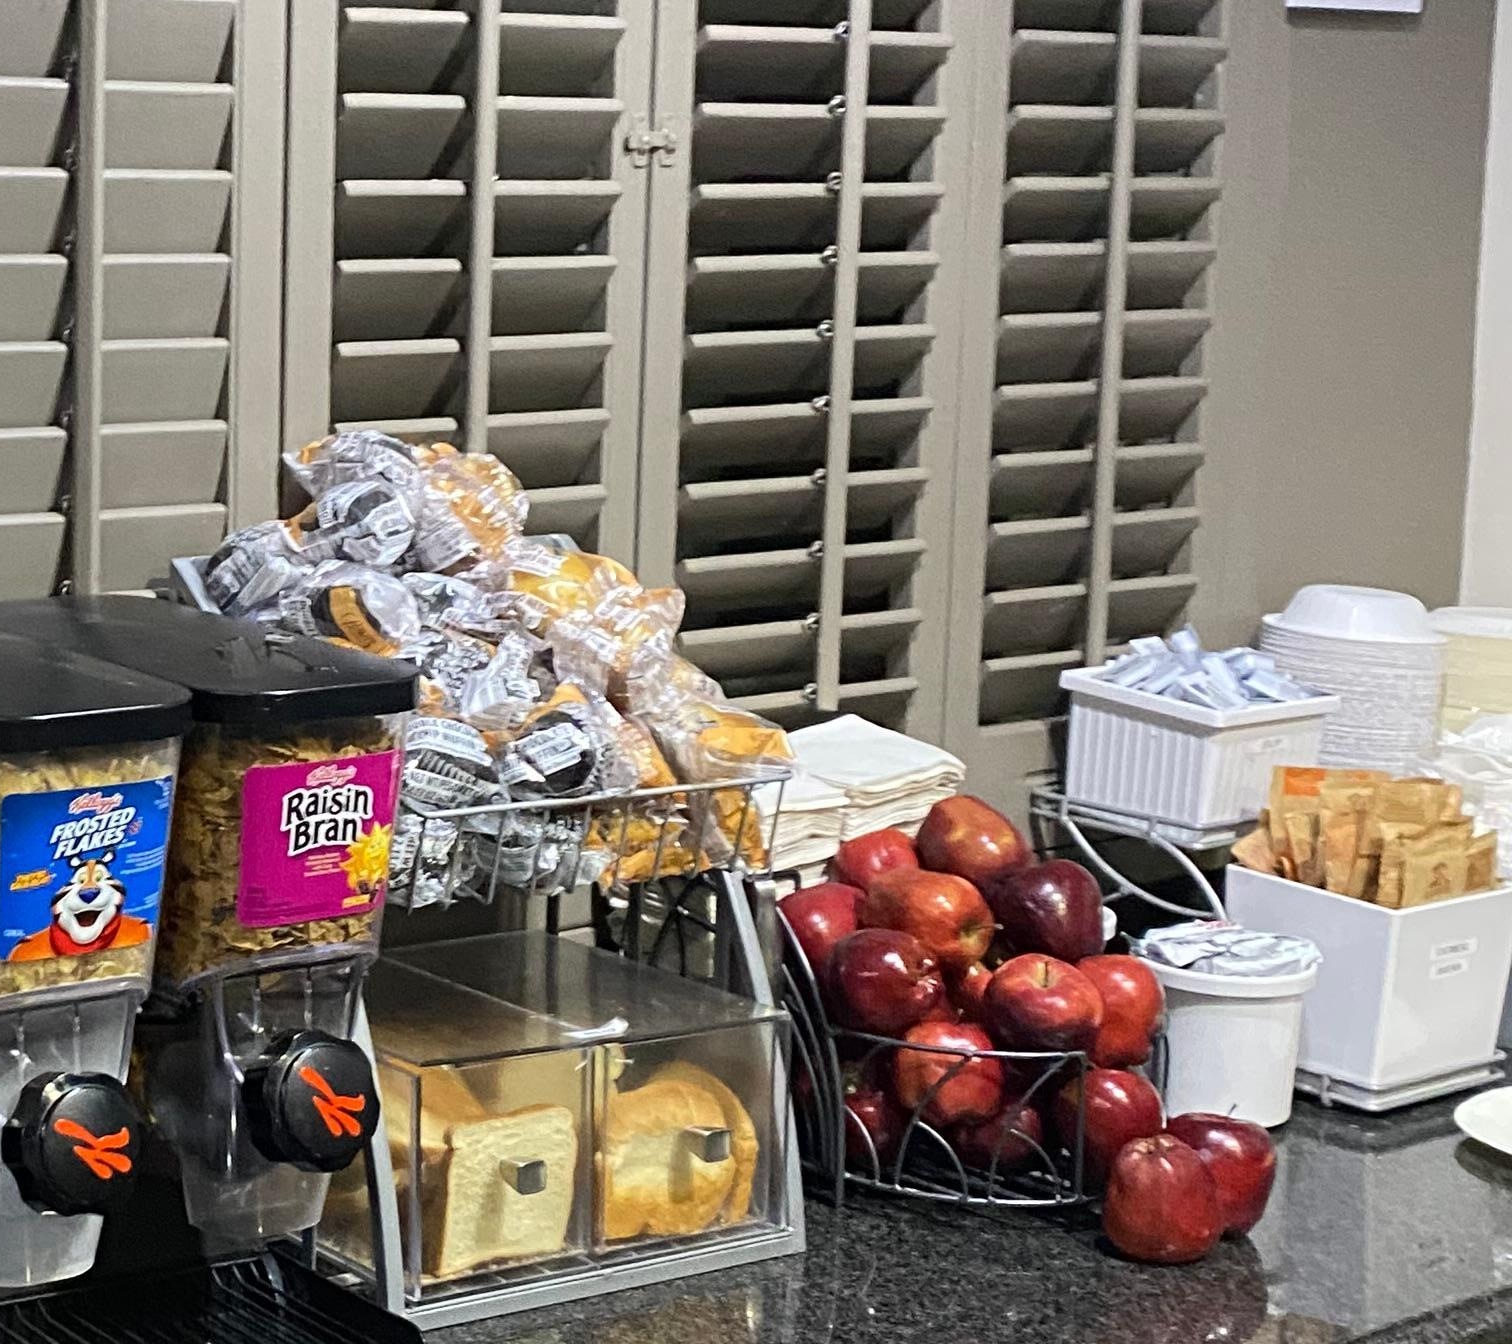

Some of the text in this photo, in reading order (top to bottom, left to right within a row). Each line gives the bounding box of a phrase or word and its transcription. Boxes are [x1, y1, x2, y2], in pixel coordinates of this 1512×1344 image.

[49, 806, 136, 845] FROSTED
[285, 787, 369, 827] Raisin
[52, 825, 127, 859] FLAKES
[293, 817, 358, 853] Bran
